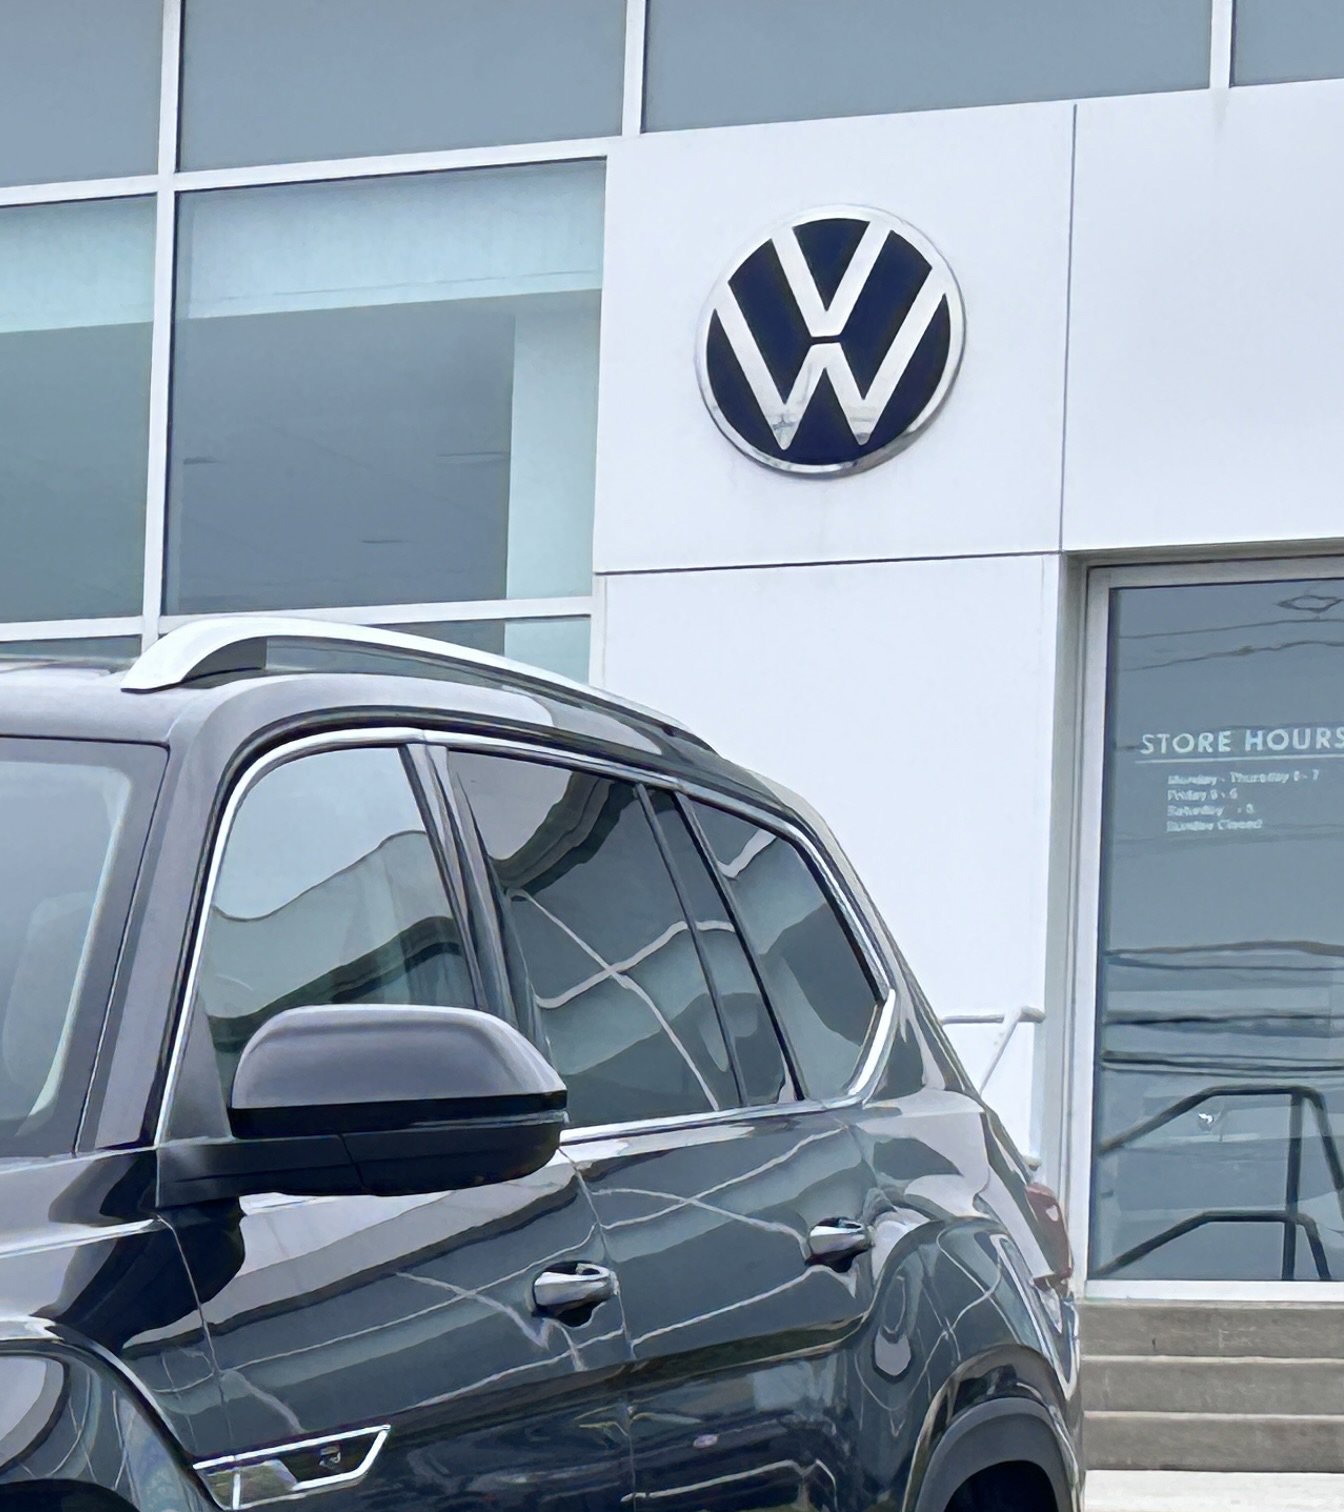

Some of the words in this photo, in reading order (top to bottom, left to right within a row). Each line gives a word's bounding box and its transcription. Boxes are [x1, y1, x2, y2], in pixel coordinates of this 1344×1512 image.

[704, 208, 956, 458] VW
[1140, 732, 1232, 754] STORE
[1245, 728, 1344, 751] HOURS
